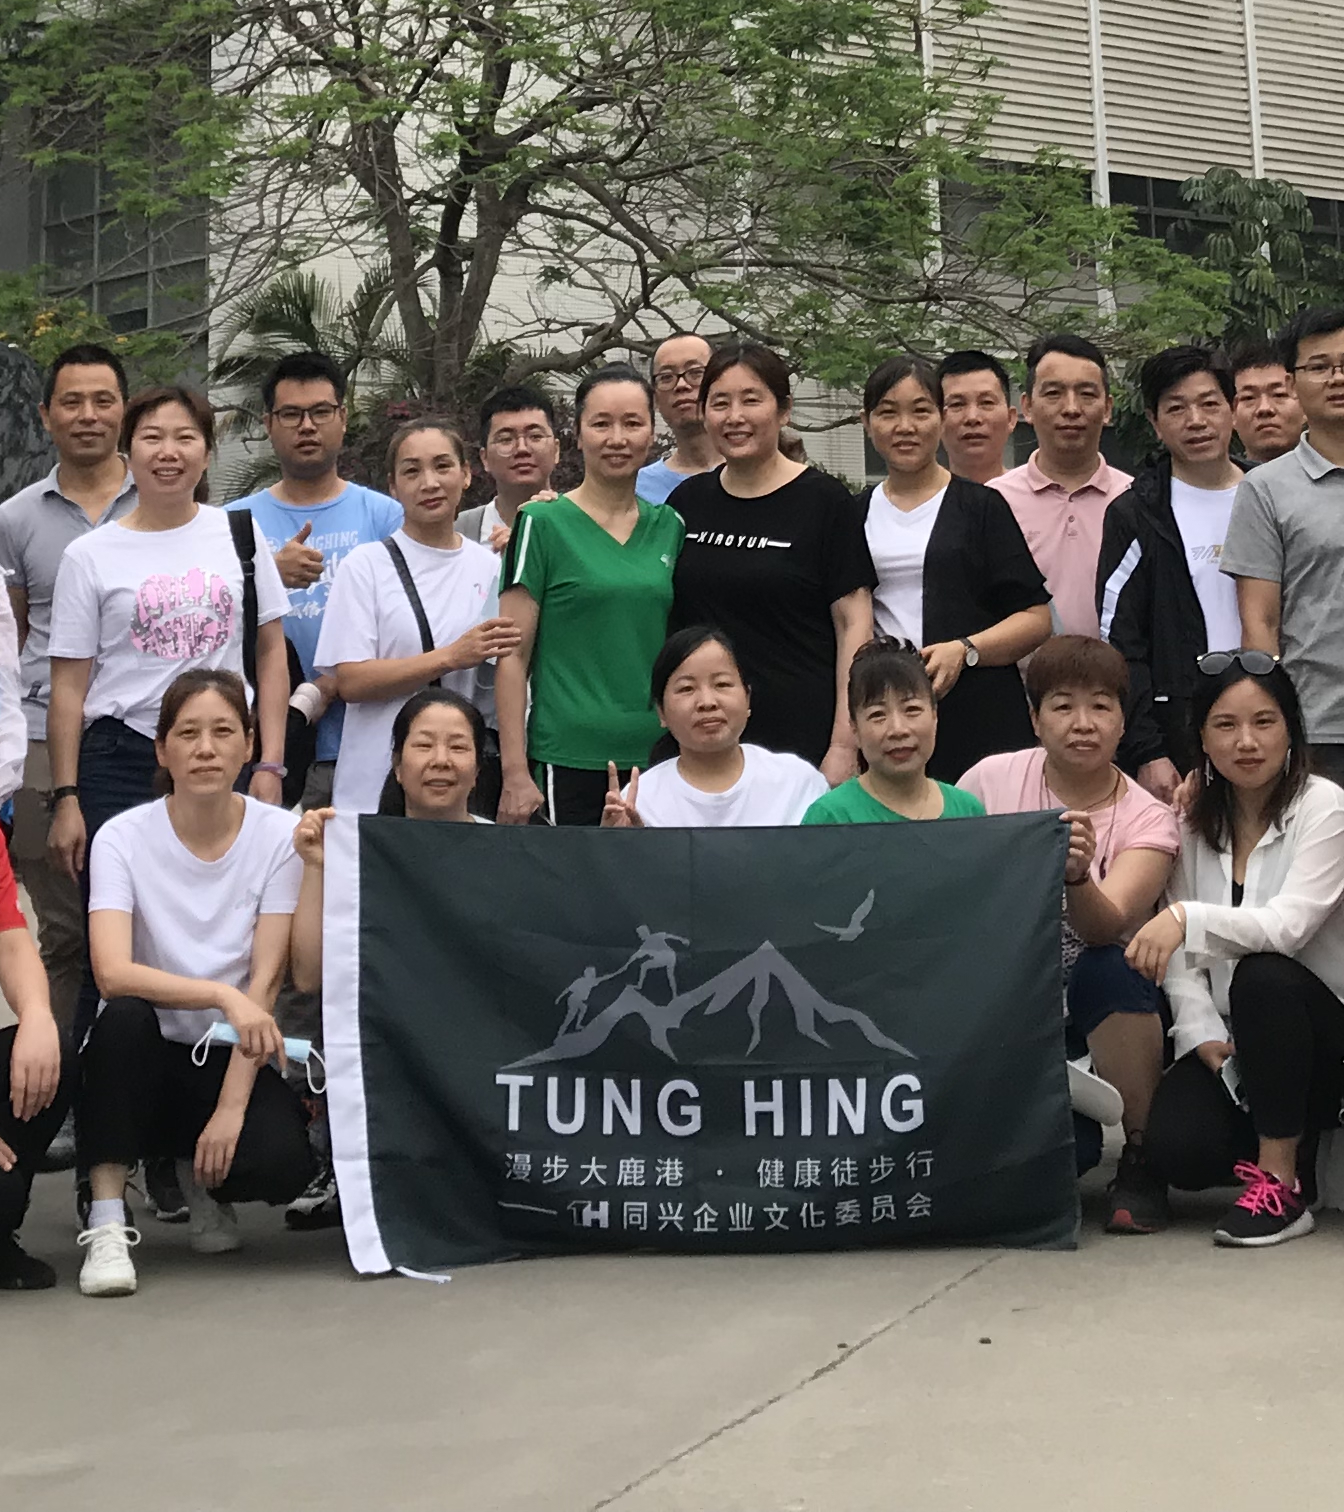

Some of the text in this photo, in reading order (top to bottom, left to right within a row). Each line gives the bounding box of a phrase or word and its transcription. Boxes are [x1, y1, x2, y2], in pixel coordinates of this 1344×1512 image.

[697, 531, 768, 548] XIAOYUN
[495, 1074, 925, 1136] TUNG HING
[505, 1150, 934, 1188] 漫步大鹿港 健康徒步行
[623, 1191, 933, 1232] 同兴企业文化委员会
